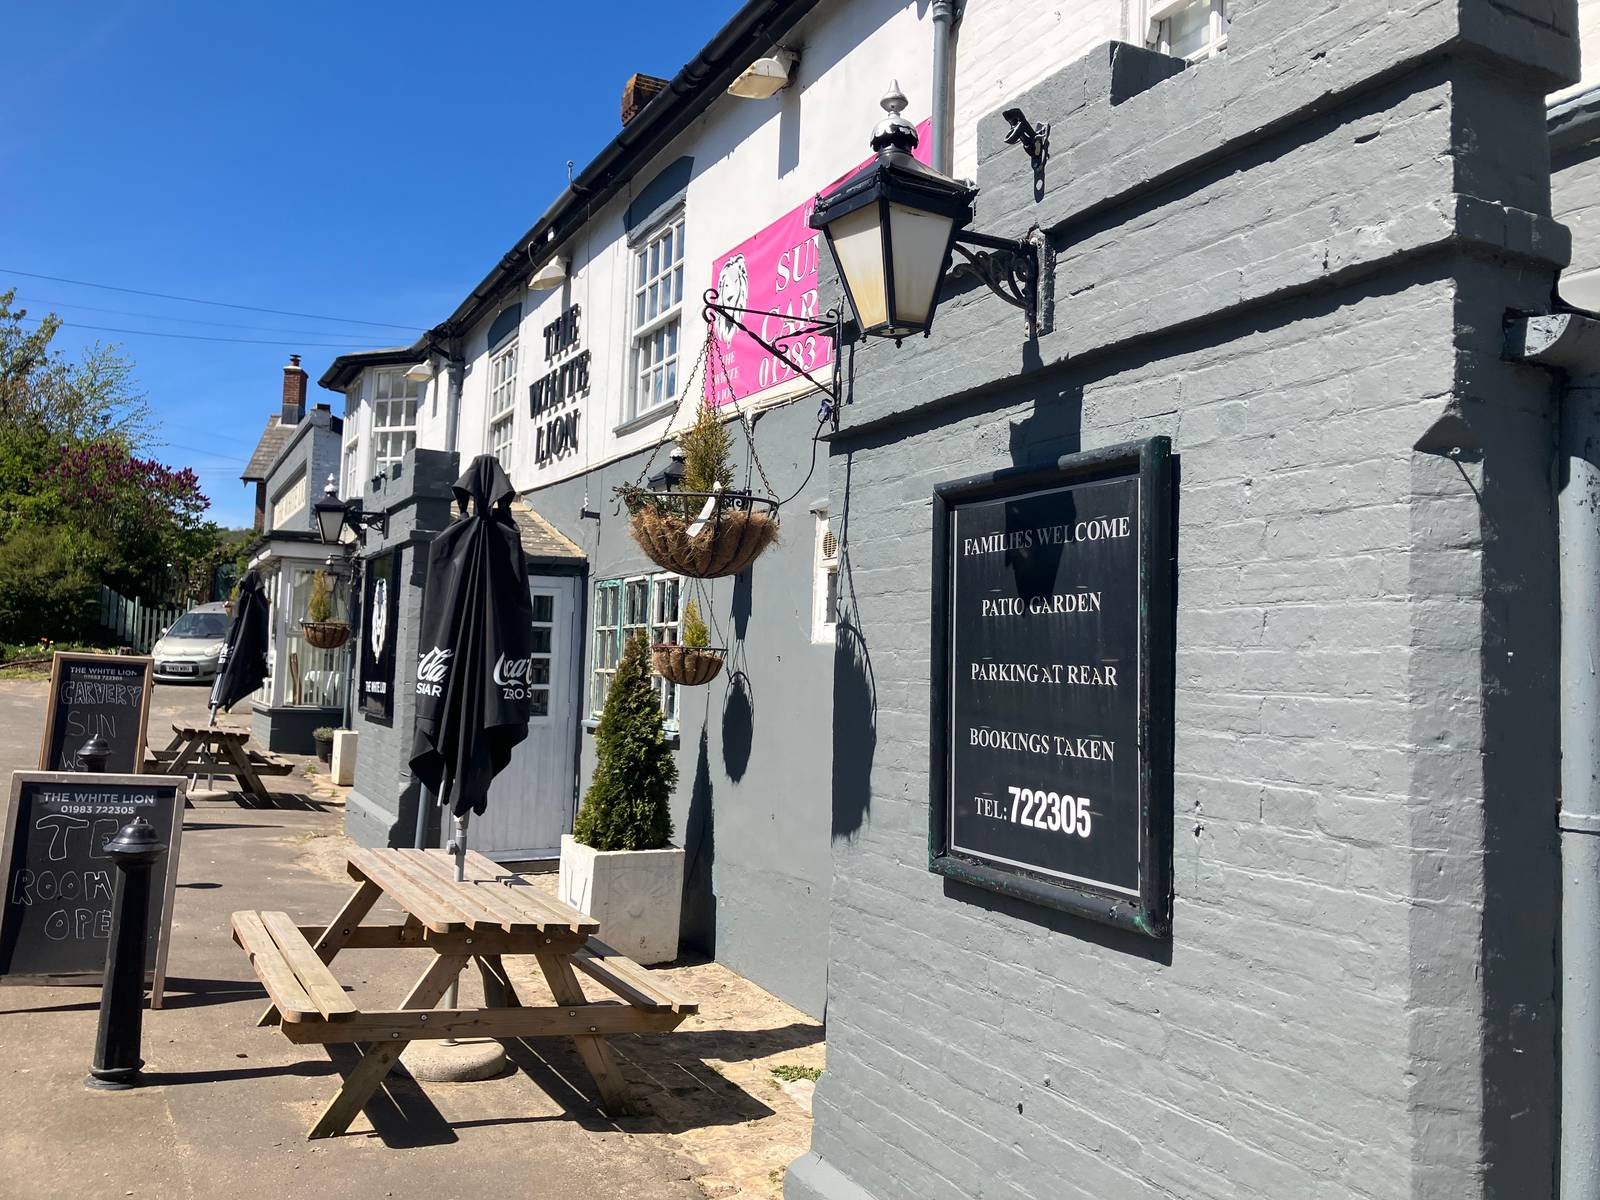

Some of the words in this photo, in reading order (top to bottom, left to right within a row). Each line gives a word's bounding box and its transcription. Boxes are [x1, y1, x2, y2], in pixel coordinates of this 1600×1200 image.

[543, 303, 579, 362] THE
[529, 349, 590, 419] WHITE
[534, 408, 579, 465] LION
[963, 529, 1033, 556] FAMILIES
[1036, 516, 1131, 545] WELCOME
[981, 597, 1025, 617] PATIO
[1029, 591, 1102, 615] GARDEN
[70, 666, 87, 674] THE
[88, 667, 118, 675] WHITE
[117, 668, 138, 676] LION
[970, 663, 1039, 684] PARKING
[1041, 664, 1063, 684] AT
[1067, 665, 1119, 686] REAR
[61, 680, 143, 707] CARVERY
[67, 710, 116, 738] SUN
[969, 727, 1050, 754] BOOKINGS
[1053, 736, 1115, 762] TAKEN
[43, 792, 71, 802] THE
[74, 793, 119, 803] WHITE
[122, 794, 154, 804] LION
[60, 805, 93, 814] 01983
[95, 805, 135, 814] 722305
[974, 796, 1007, 821] TEL:
[1008, 785, 1092, 838] 722305
[36, 814, 148, 861] TE
[45, 908, 112, 940] OPE
